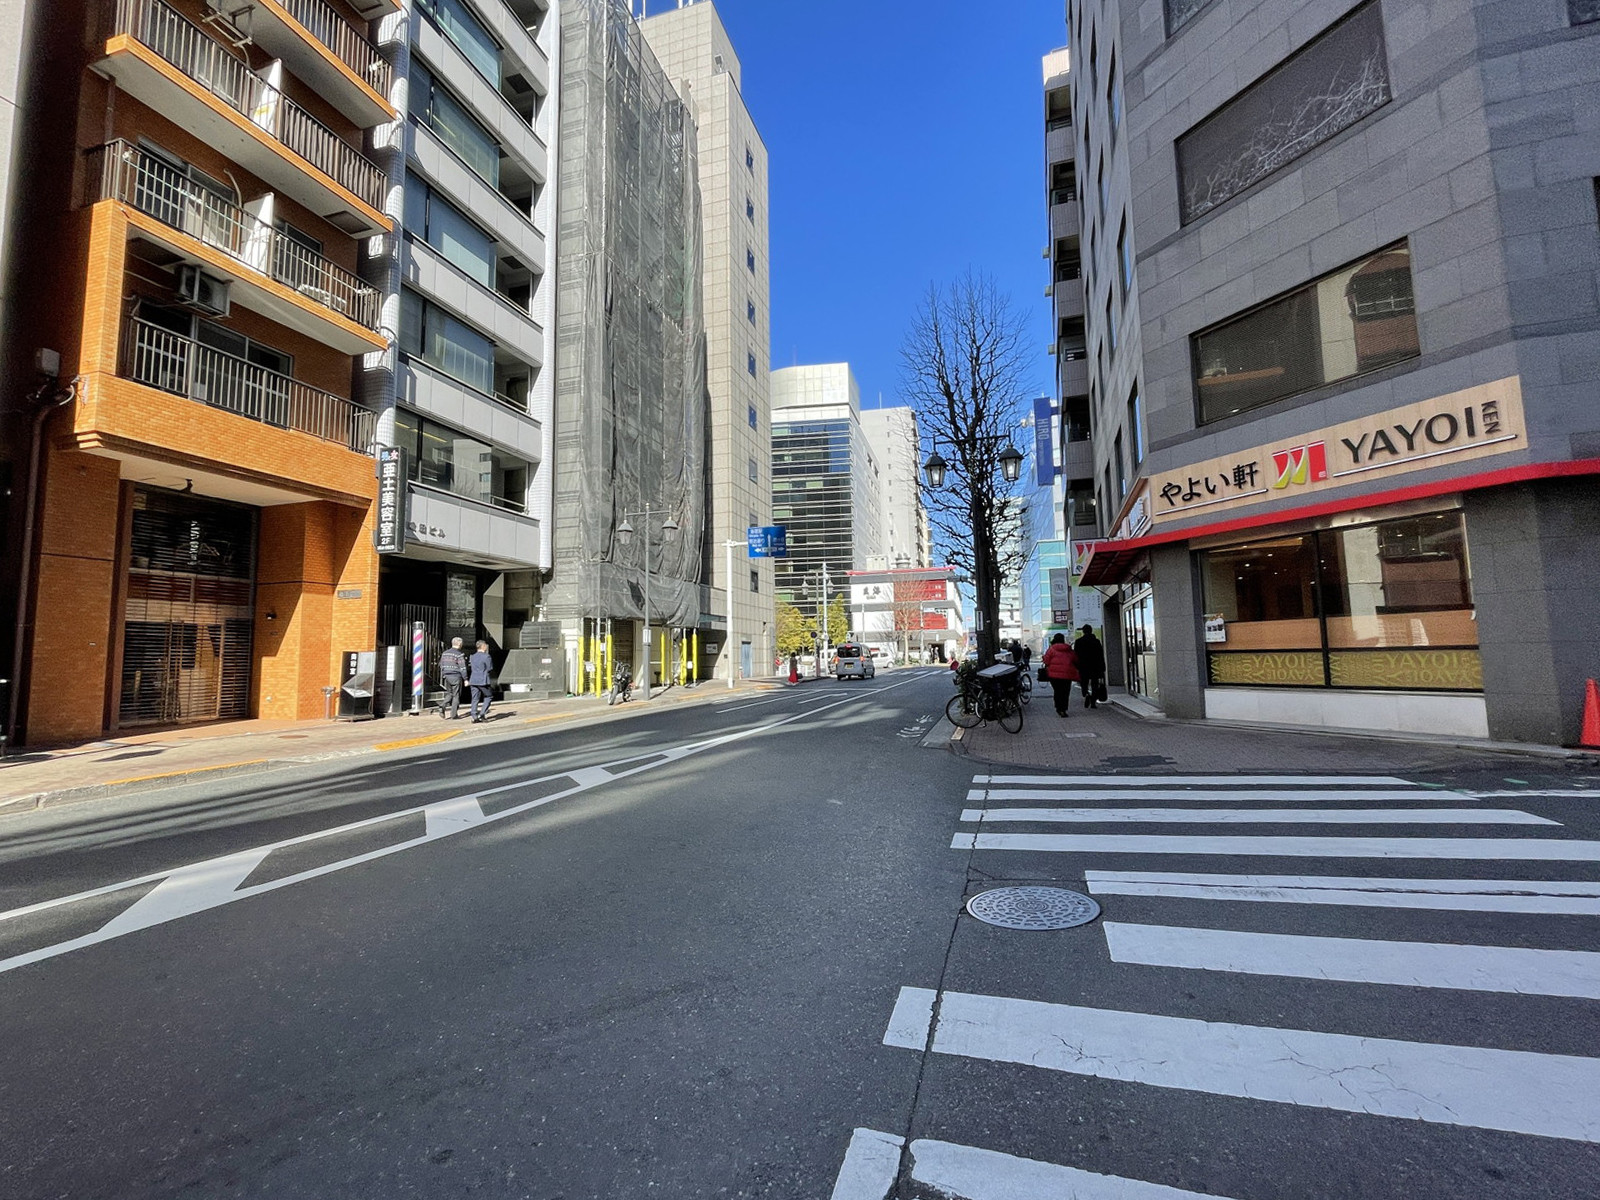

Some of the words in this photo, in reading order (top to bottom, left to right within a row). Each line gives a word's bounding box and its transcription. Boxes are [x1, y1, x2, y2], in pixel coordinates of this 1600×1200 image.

[1037, 418, 1049, 440] HIRO
[1481, 400, 1501, 434] KEN
[1340, 406, 1476, 464] YAYOI
[380, 462, 396, 537] 亜土美容室
[1159, 461, 1260, 505] やよい軒
[1251, 654, 1306, 669] YAYOI
[1385, 652, 1458, 669] YAYOI
